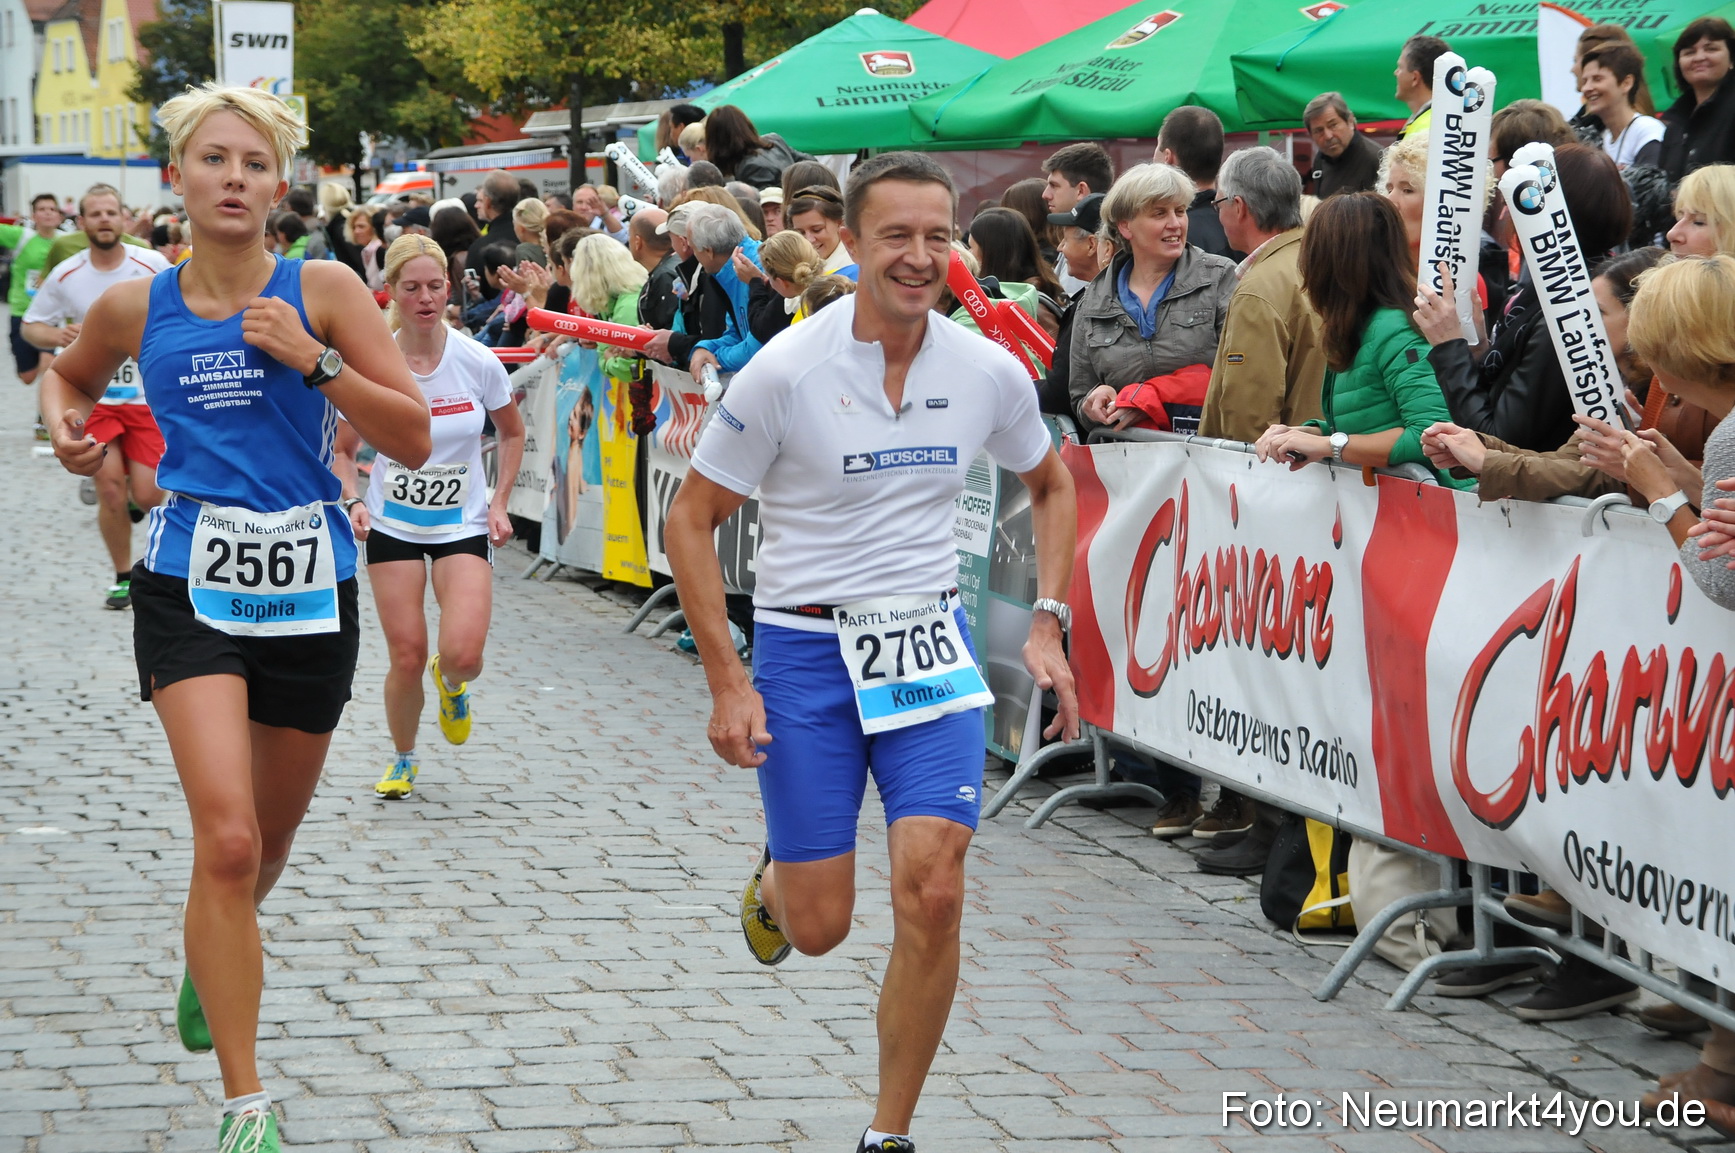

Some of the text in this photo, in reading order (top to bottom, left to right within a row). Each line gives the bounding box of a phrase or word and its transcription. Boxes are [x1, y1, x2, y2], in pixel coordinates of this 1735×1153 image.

[1467, 0, 1652, 16] Neuarkter
[1412, 11, 1668, 37] Lammräu
[230, 33, 288, 48] swn
[837, 82, 951, 94] Neumarkte
[1439, 113, 1463, 179] BMW
[1530, 230, 1578, 305] BMW
[588, 325, 637, 341] Audi BKK
[179, 369, 265, 385] RAMSAUER
[202, 381, 242, 391] ZIMMEREI
[187, 390, 262, 404] DACHEINDECKUNG
[203, 399, 251, 410] GERÜSTBAU
[438, 405, 469, 414] Apotheke
[880, 449, 953, 467] BÜSCHEL
[842, 467, 958, 483] FEINSCHNEIDTECHNIK WERKZEUGBAU
[392, 475, 461, 506] 3322
[962, 494, 992, 517] HOFFER
[200, 514, 305, 535] PARTL Neumarkt
[206, 536, 319, 587] 2567
[1124, 478, 1342, 699] Charivari
[231, 598, 295, 623] Sophia
[839, 604, 938, 629] PARTL Neumarkt
[856, 620, 958, 681] 2766
[891, 679, 956, 708] Konrad
[1187, 688, 1358, 789] Ostbayerns Radio
